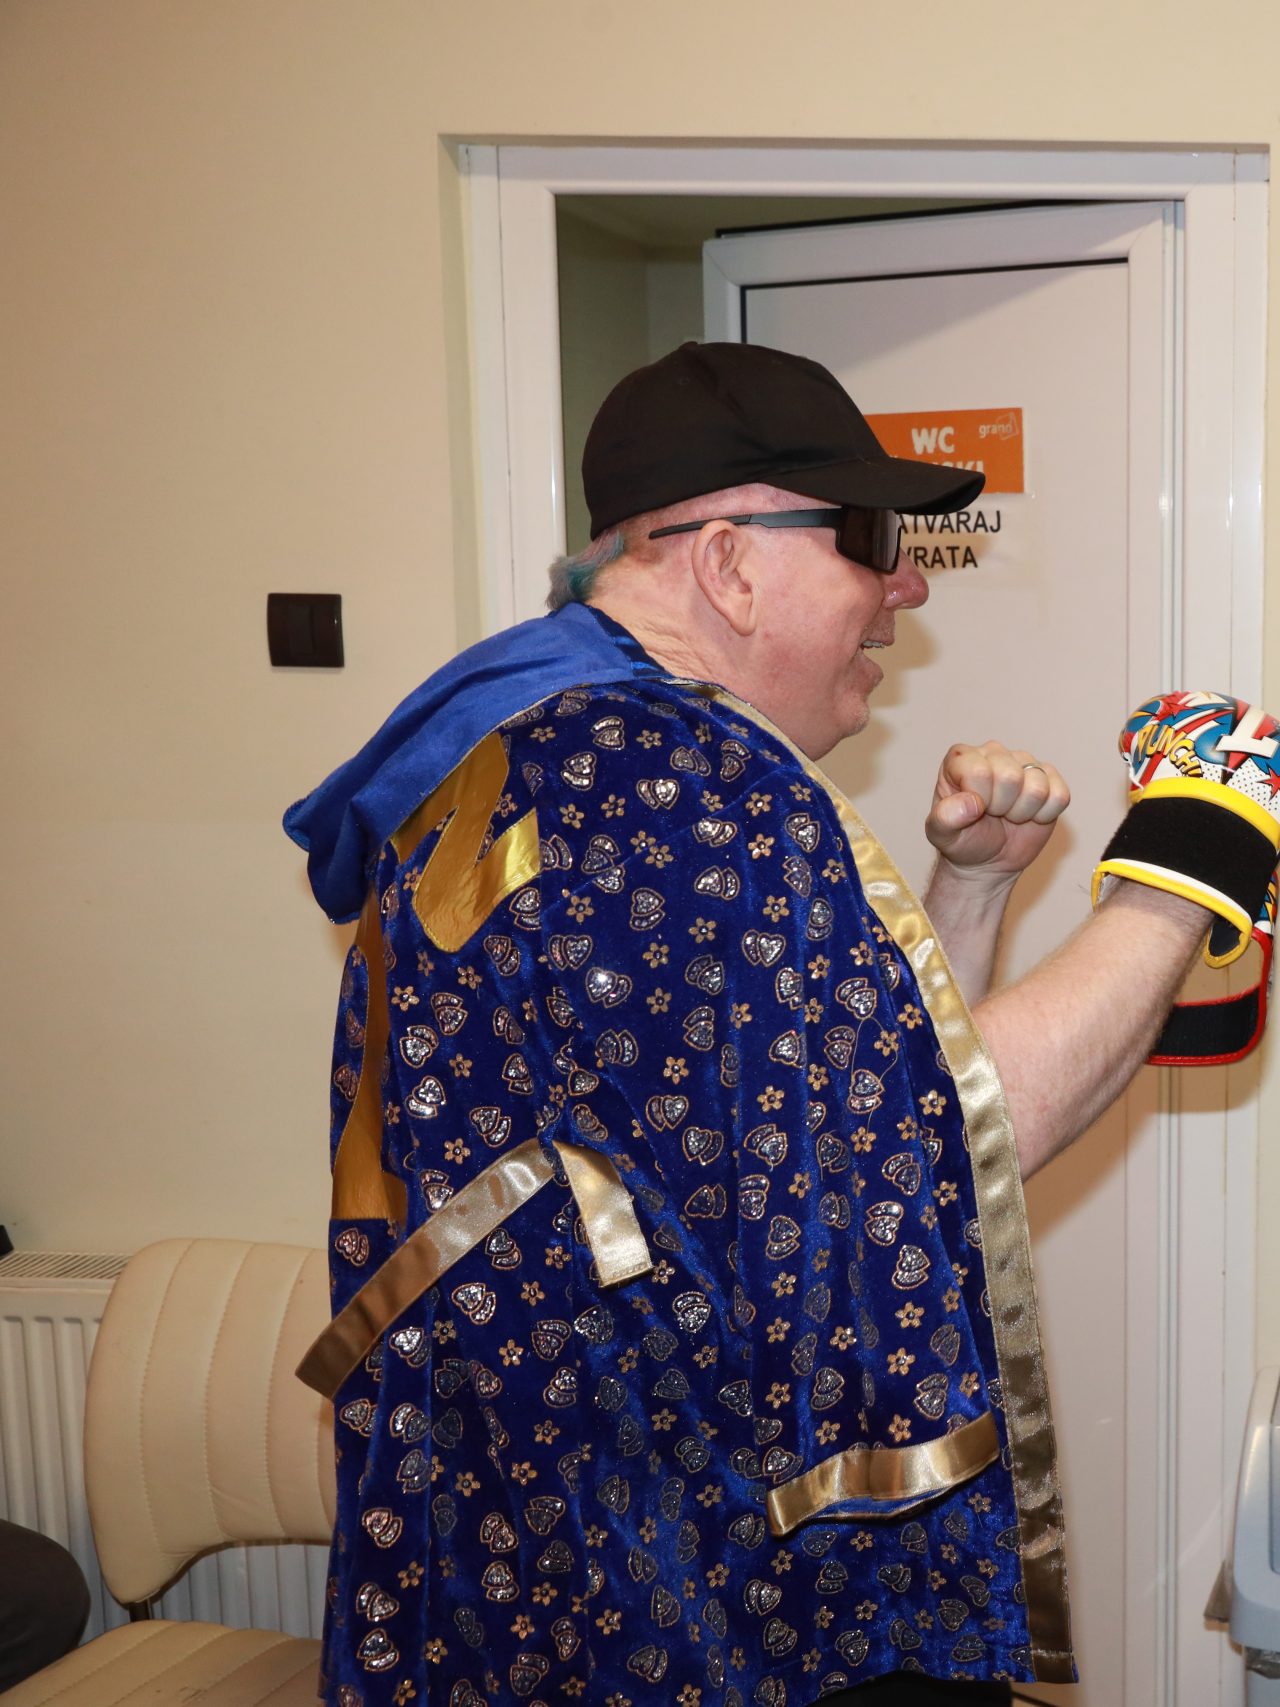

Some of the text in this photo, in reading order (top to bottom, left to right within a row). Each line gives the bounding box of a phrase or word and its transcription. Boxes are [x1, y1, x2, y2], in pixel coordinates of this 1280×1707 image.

[911, 426, 955, 455] WC
[899, 510, 1001, 534] ATVARAJ
[907, 545, 978, 569] RATA
